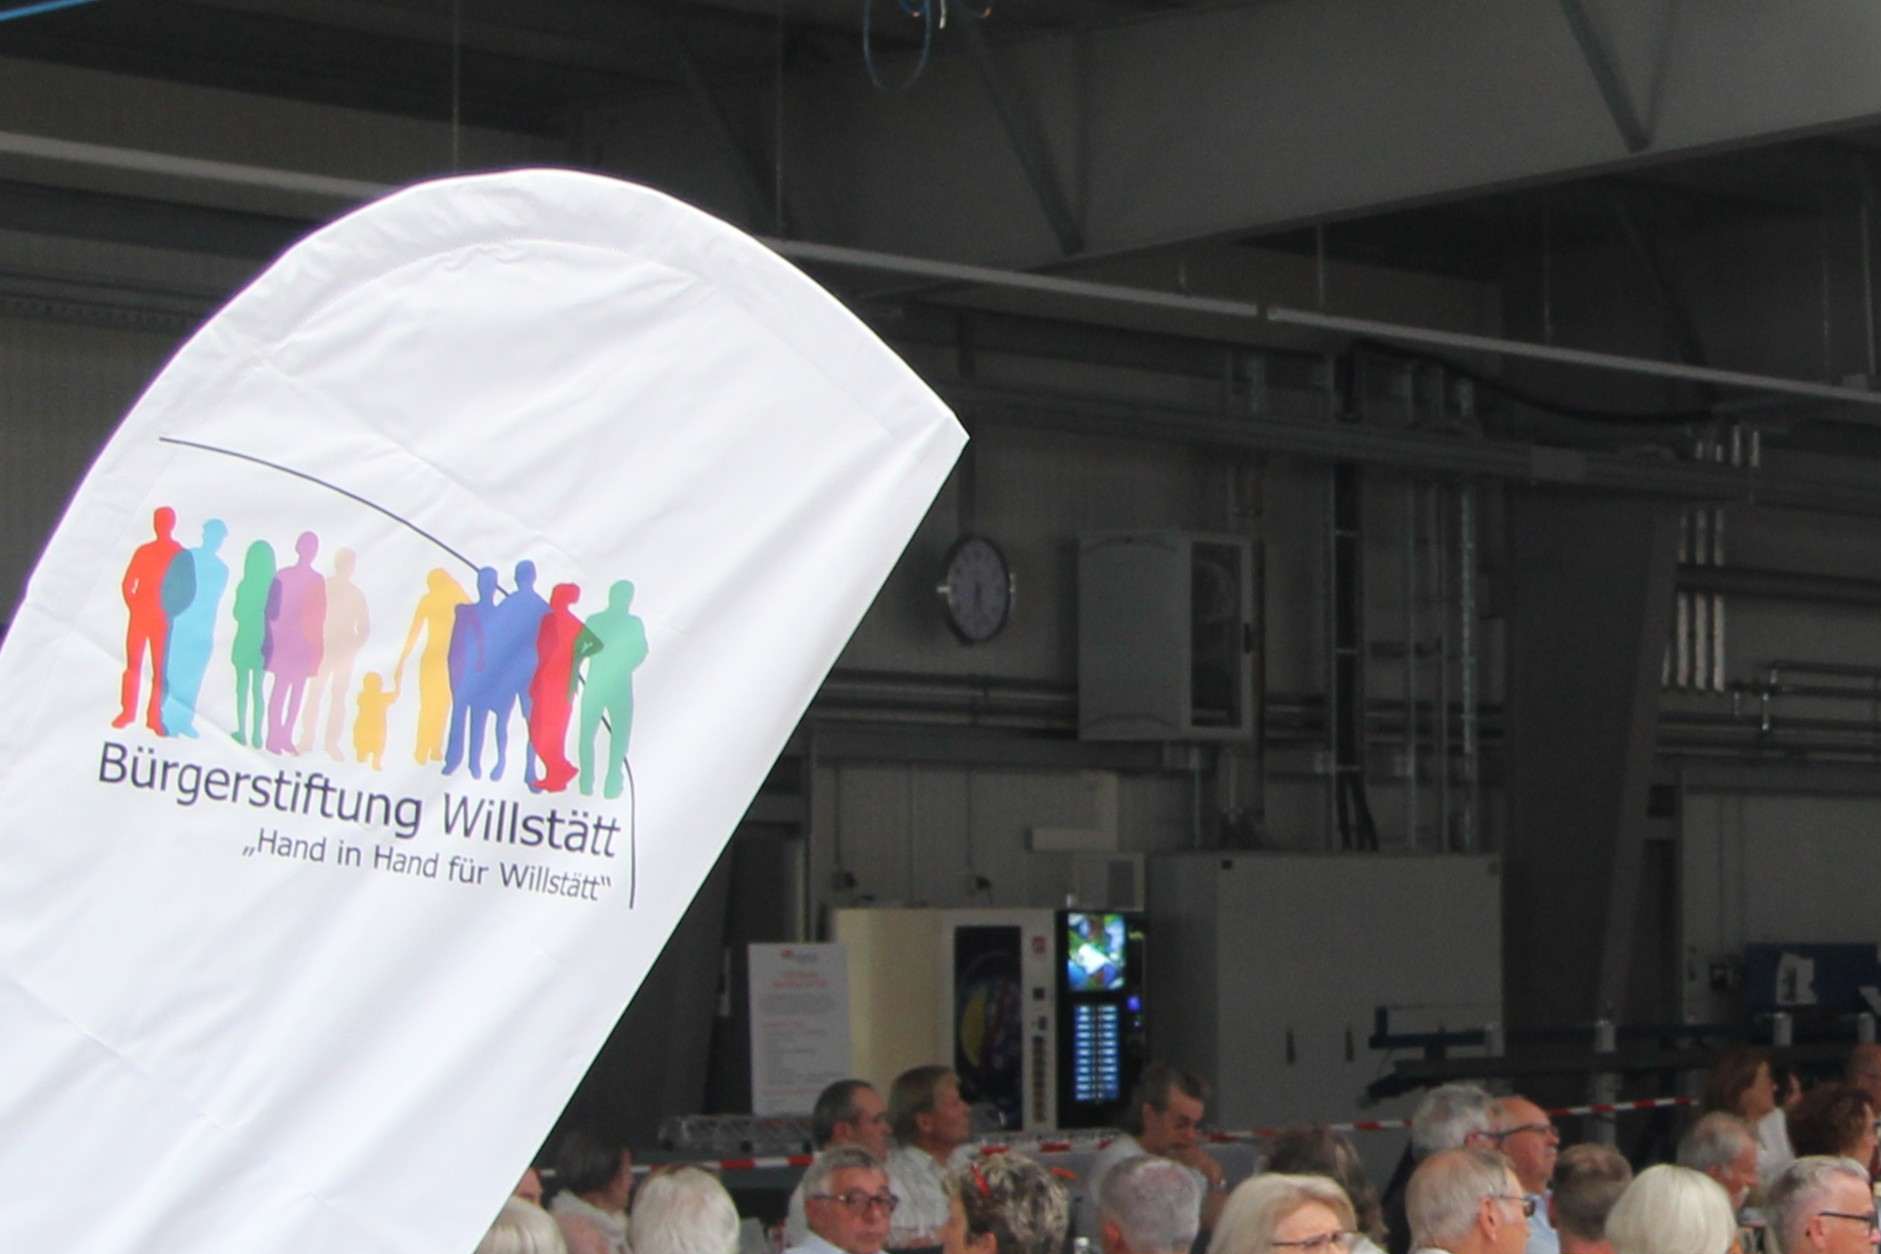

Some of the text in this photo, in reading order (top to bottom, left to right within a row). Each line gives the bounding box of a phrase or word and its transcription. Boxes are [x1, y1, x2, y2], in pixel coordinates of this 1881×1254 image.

[98, 741, 621, 857] Bürgerstiftung Willstätt
[337, 840, 362, 867] in
[374, 845, 440, 879] Hand
[448, 855, 489, 885] für
